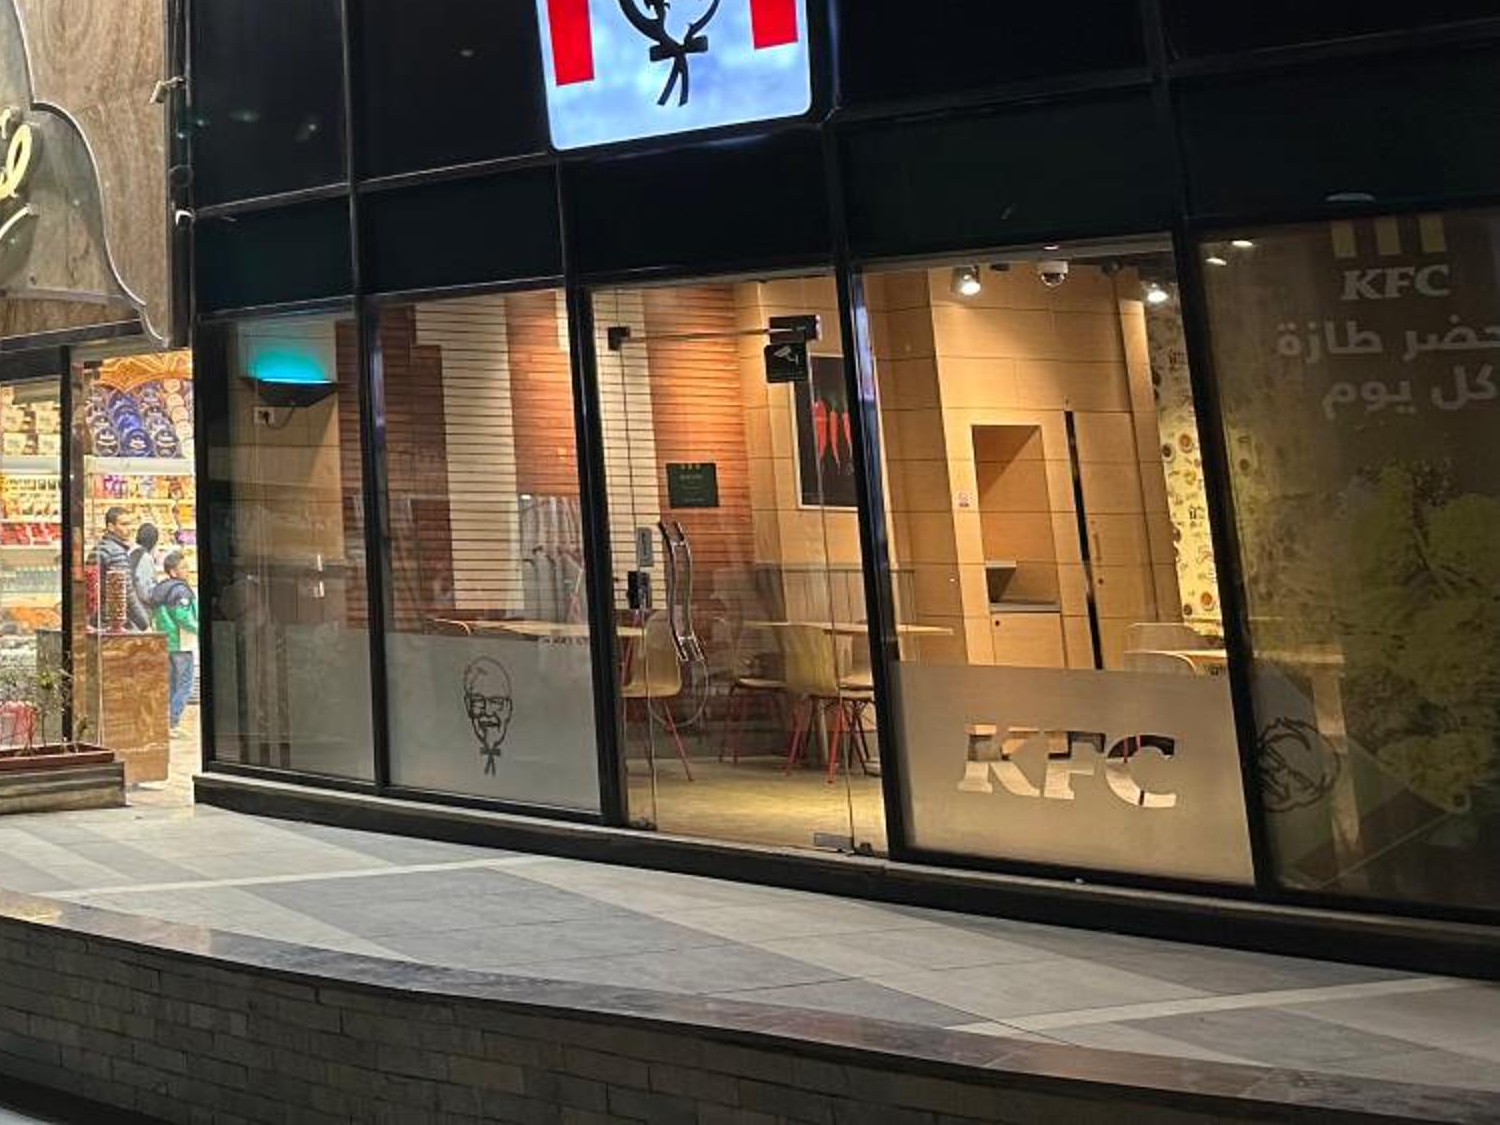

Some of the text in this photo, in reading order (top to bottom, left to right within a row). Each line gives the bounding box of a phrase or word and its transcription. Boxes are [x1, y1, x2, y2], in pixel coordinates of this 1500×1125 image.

[1339, 263, 1450, 300] KFC
[1276, 320, 1383, 364] طازة
[1321, 362, 1498, 420] كل يوم
[956, 723, 1178, 809] KFC
